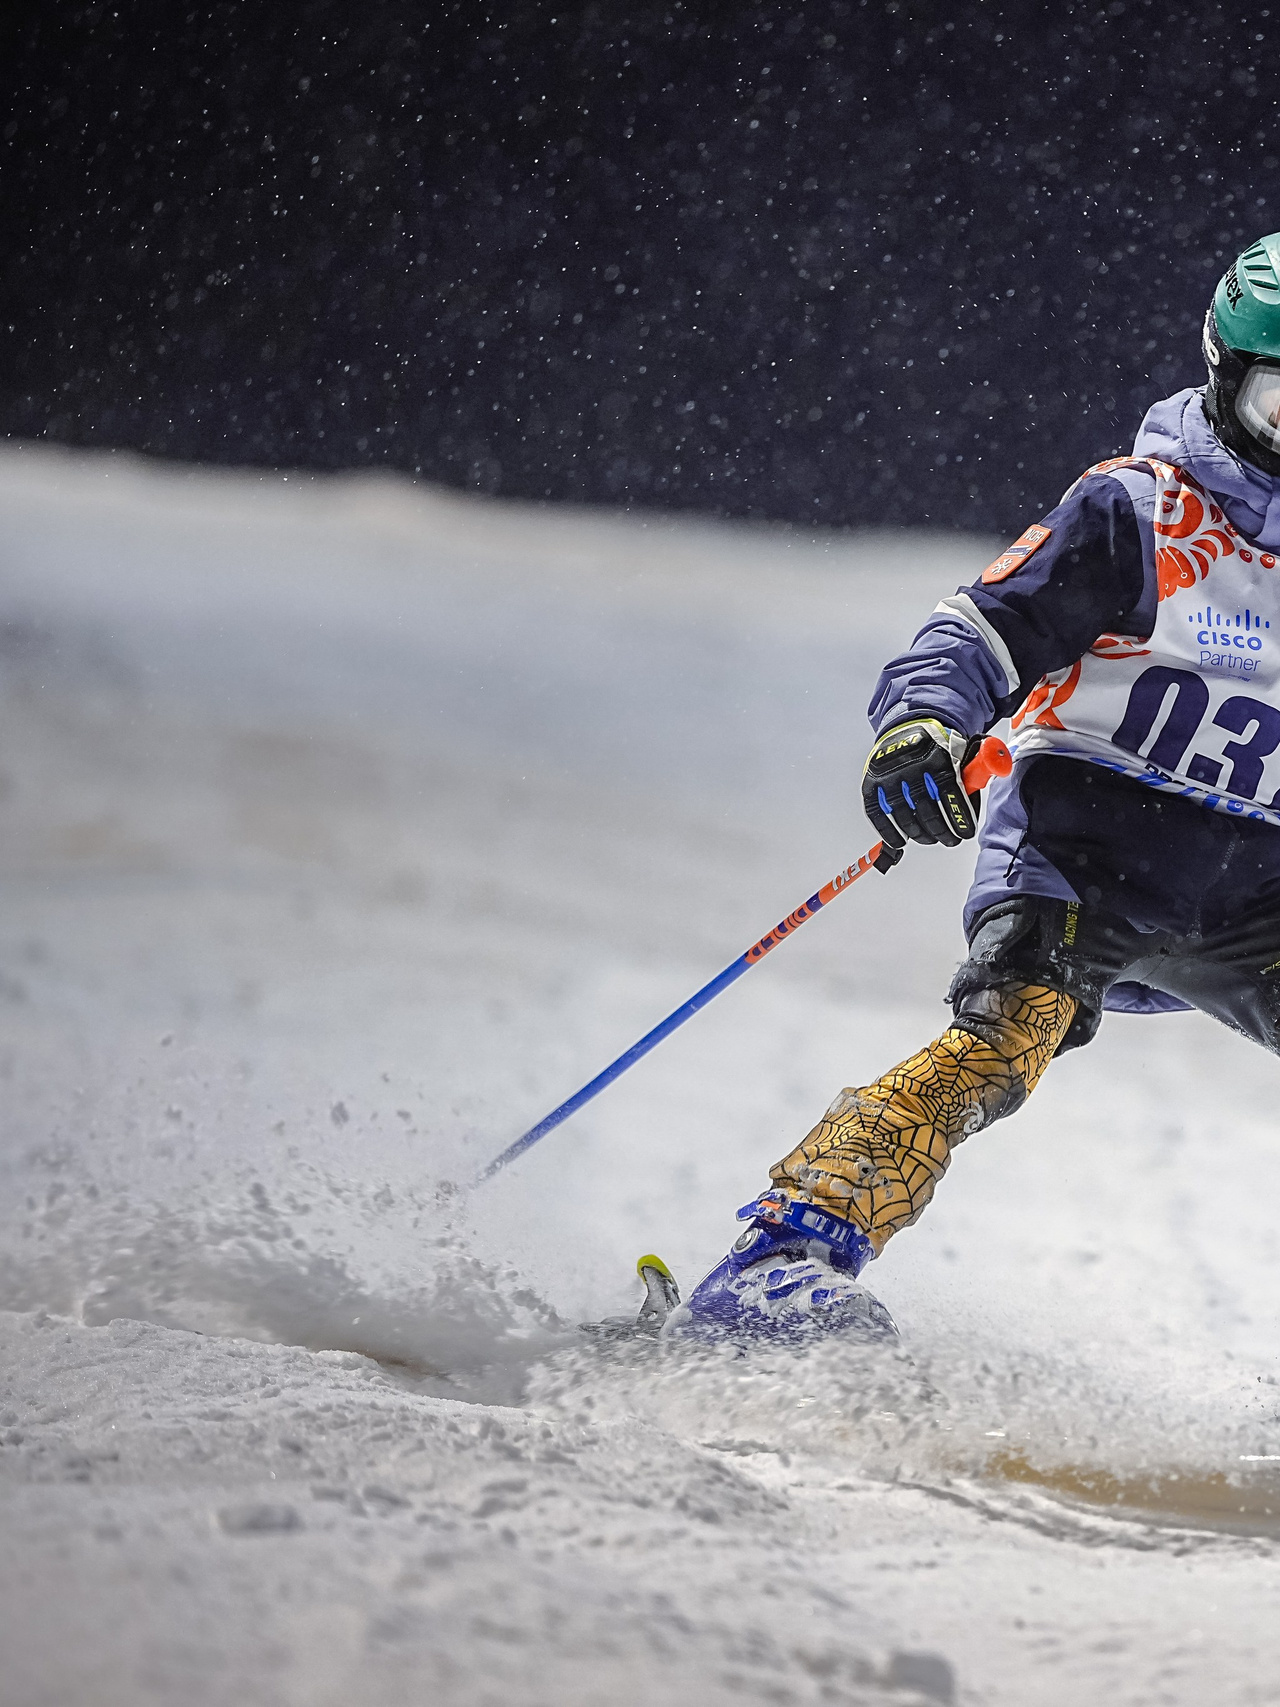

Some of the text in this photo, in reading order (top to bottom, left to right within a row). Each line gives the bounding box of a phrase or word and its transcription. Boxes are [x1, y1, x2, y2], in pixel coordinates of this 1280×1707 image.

[1023, 528, 1045, 543] NOR
[1197, 630, 1263, 651] CISCO
[1200, 650, 1262, 672] Partner
[875, 733, 922, 760] LEKI
[947, 794, 968, 830] LEKI
[832, 852, 872, 891] LEKI
[1063, 912, 1078, 946] RACING
